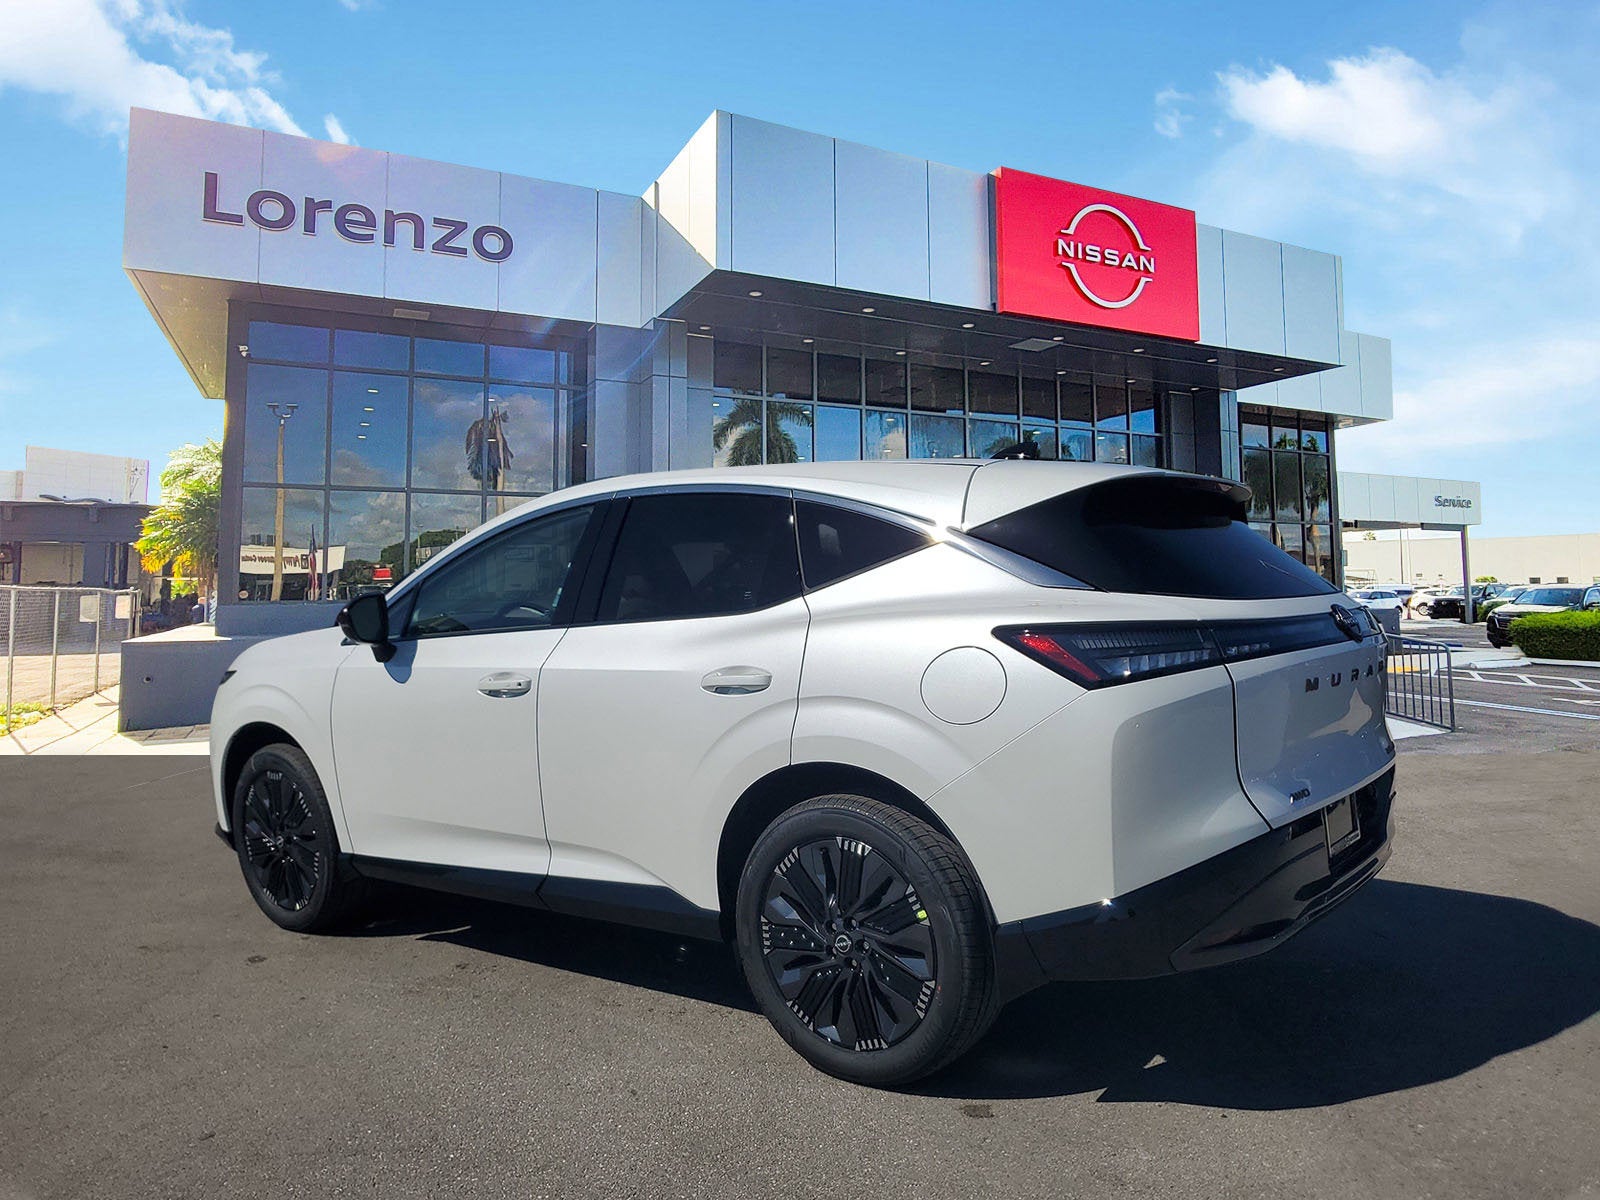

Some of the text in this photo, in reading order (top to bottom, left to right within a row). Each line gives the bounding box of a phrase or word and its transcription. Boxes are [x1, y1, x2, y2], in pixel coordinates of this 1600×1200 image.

[202, 171, 515, 262] Lorenzo
[1056, 238, 1156, 273] NISSAN
[1434, 495, 1472, 508] Service
[1290, 788, 1311, 804] AWD
